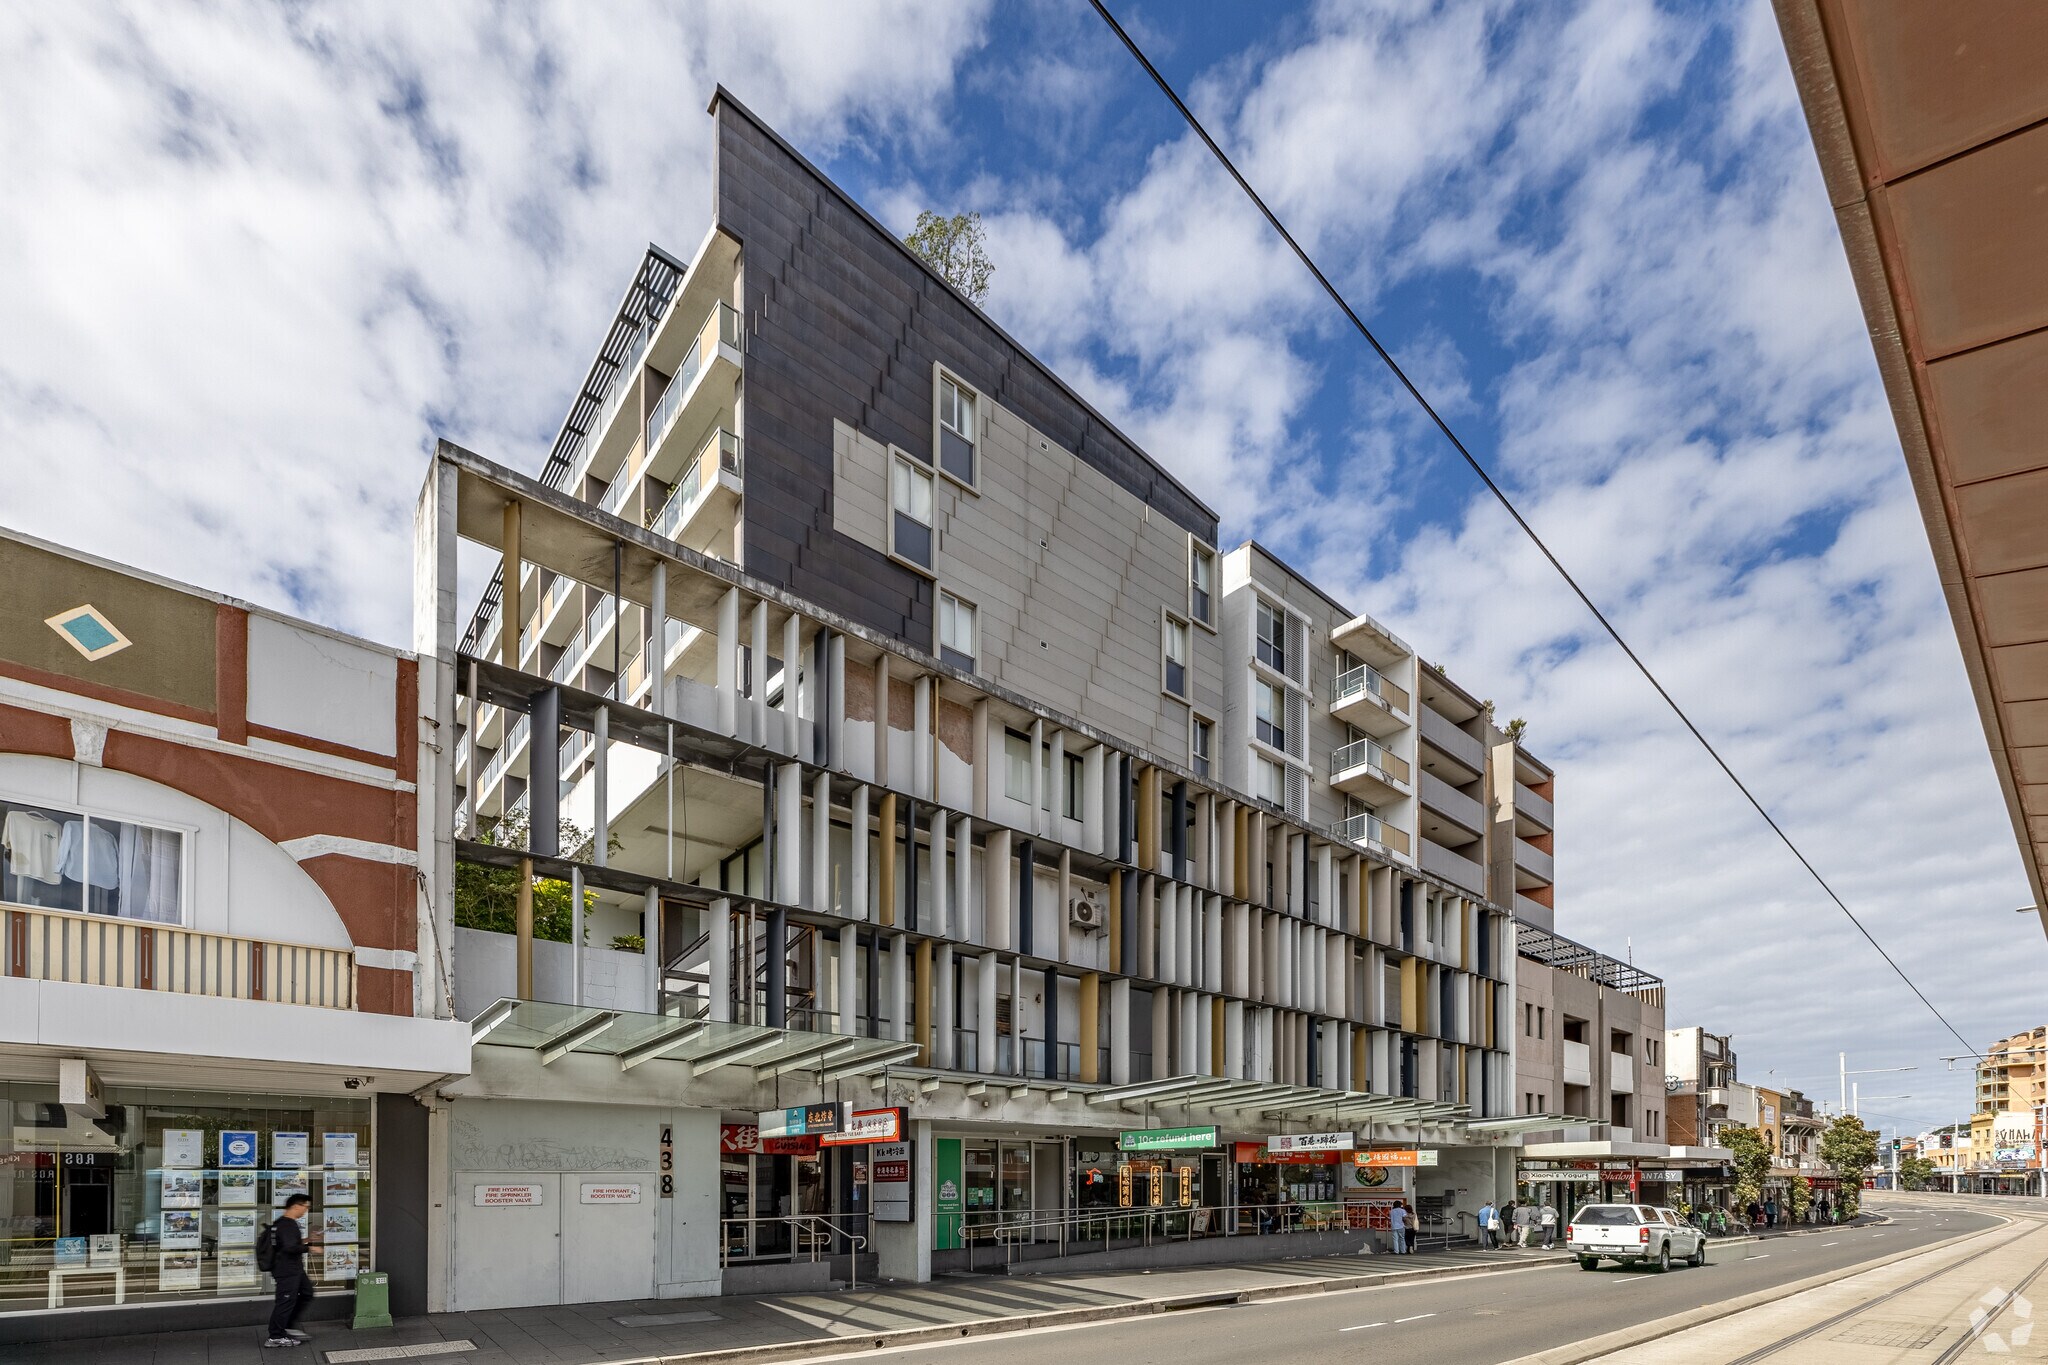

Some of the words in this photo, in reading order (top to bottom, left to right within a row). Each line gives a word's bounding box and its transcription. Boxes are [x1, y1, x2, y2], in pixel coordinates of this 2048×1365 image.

[1138, 1135, 1153, 1144] 10c
[1156, 1133, 1187, 1143] refund
[1189, 1132, 1212, 1141] here
[774, 1141, 812, 1150] CUISINE
[660, 1128, 673, 1194] 438
[1600, 1171, 1635, 1181] Shalom
[1641, 1172, 1676, 1180] ANTASY
